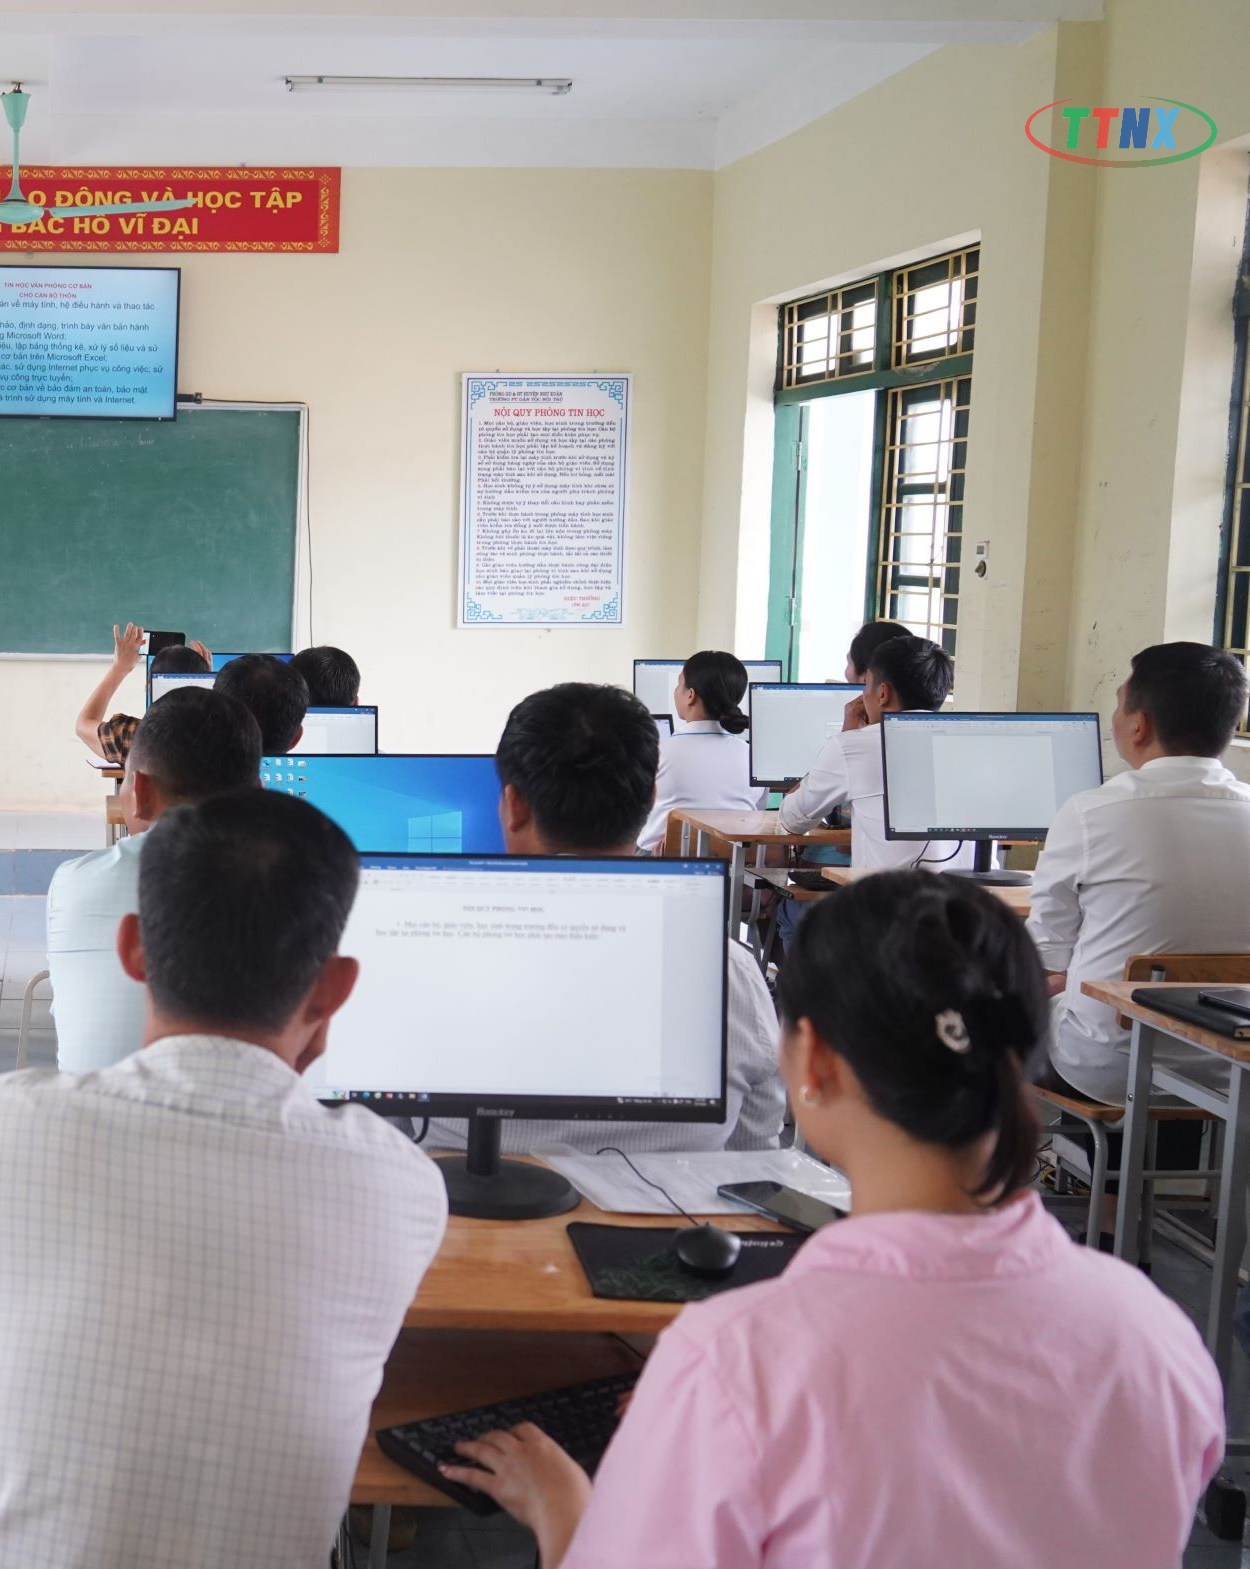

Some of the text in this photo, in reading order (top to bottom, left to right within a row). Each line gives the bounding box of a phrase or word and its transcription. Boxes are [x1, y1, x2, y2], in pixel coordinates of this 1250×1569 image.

[187, 190, 242, 213] HỌC
[250, 187, 302, 214] TẬP
[119, 213, 146, 234] VĨ
[152, 218, 198, 239] ĐẠI
[494, 407, 510, 418] NỘI
[513, 409, 532, 417] QUY
[535, 407, 566, 416] PHÒNG
[587, 409, 605, 418] HỌC
